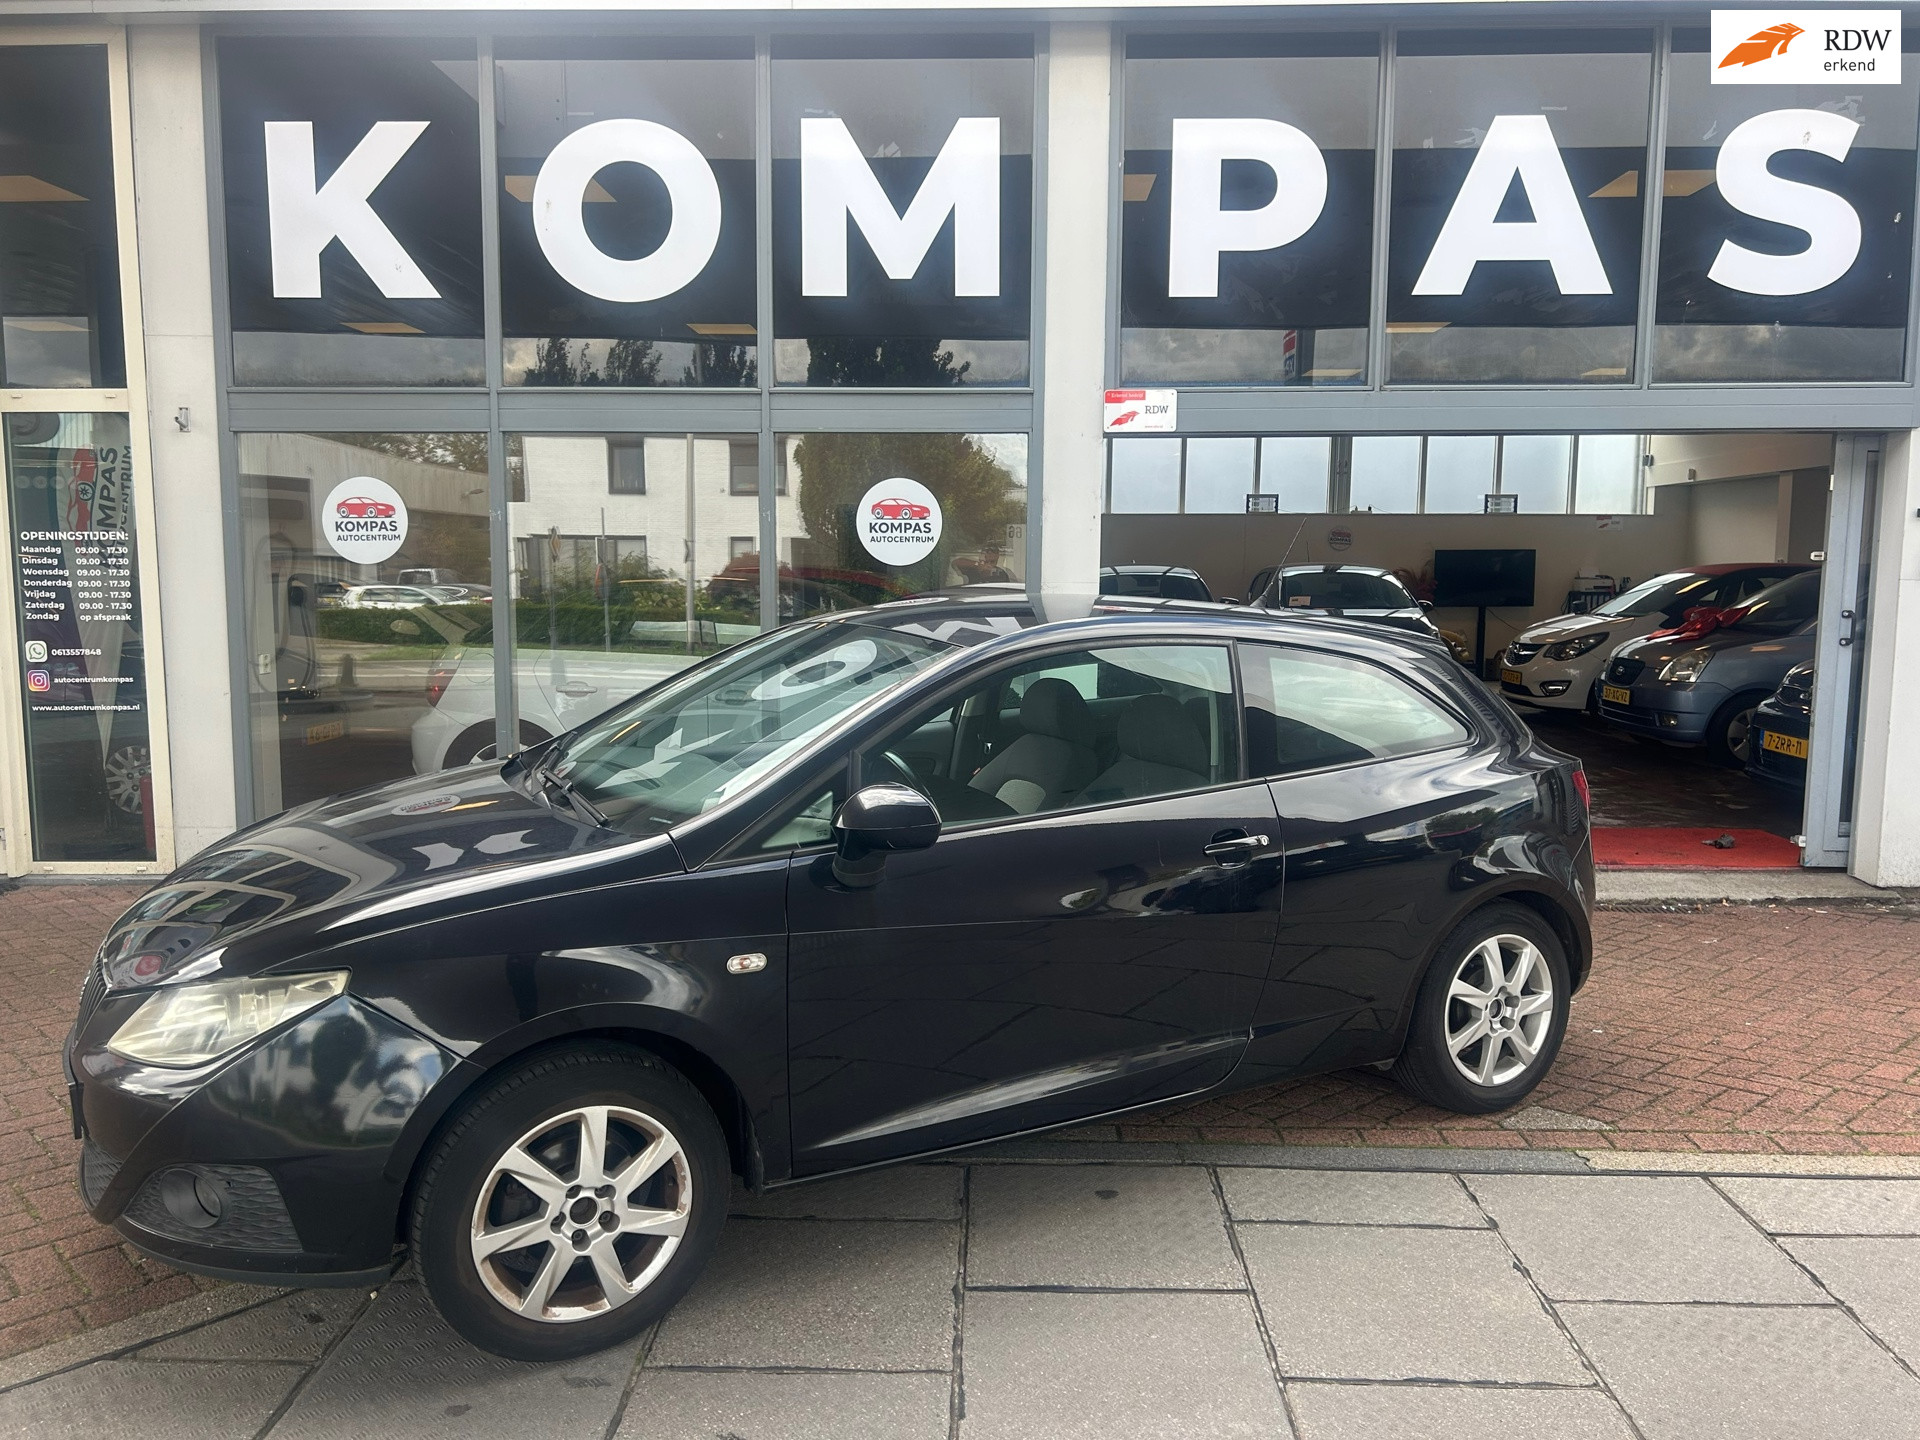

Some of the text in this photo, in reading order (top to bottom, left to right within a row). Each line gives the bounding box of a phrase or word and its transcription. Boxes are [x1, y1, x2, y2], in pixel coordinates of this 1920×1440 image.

[264, 109, 1862, 303] KOMPAS
[1145, 405, 1169, 414] RDW
[335, 521, 398, 532] KOMPAS
[869, 522, 932, 533] KOMPAS
[20, 531, 129, 540] OPENINGSTIJDEN:
[21, 545, 61, 555] Maandag
[22, 557, 58, 565] Dinsdag
[23, 568, 69, 576] Woensdag
[24, 579, 72, 587] Donderdag
[24, 590, 56, 599] Vrijdag
[25, 601, 65, 610] Zaterdag
[26, 612, 60, 621] Zondag
[94, 613, 131, 621] afspraak
[53, 676, 134, 684] autocentrumkompas
[32, 704, 140, 712] www.autocentrumkompas.nl
[1767, 734, 1803, 755] 7-ZRR-11
